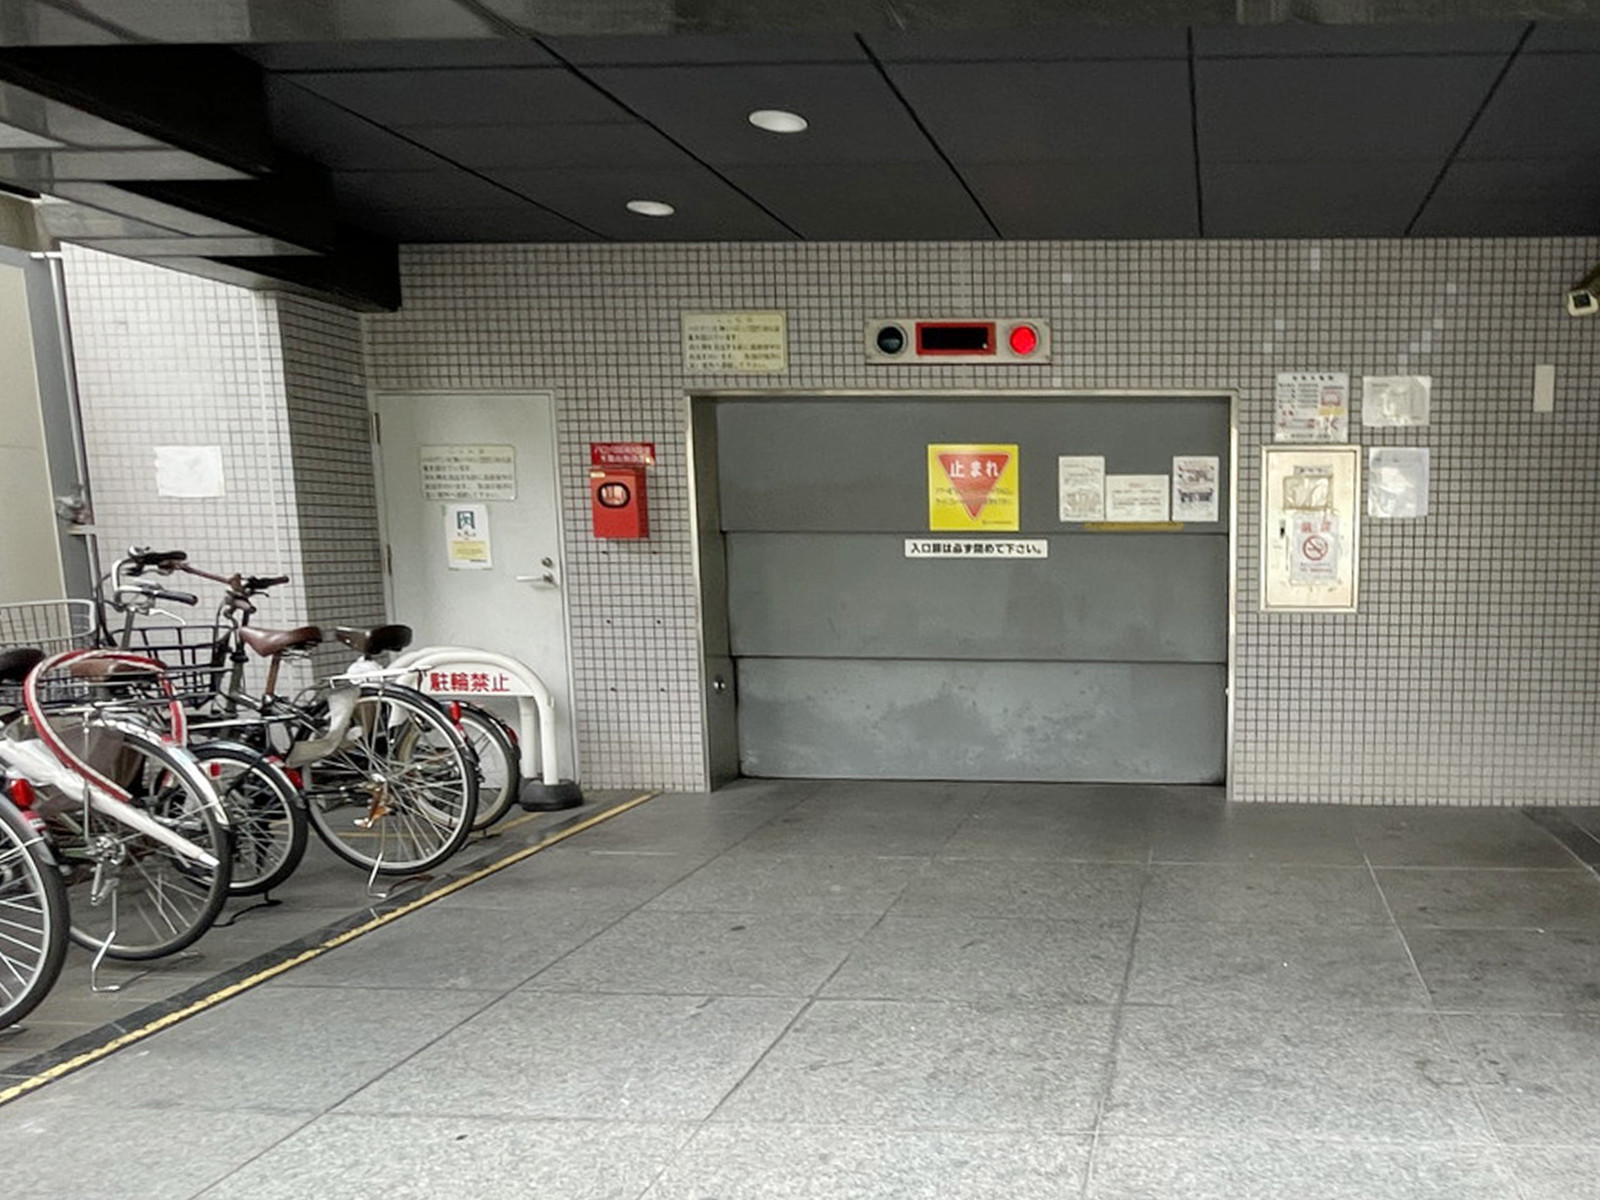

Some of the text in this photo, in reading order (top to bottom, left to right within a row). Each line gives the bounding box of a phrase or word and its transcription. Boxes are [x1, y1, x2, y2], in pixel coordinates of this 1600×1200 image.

[950, 460, 998, 478] 止まれ
[430, 672, 510, 692] 駐輪禁止
